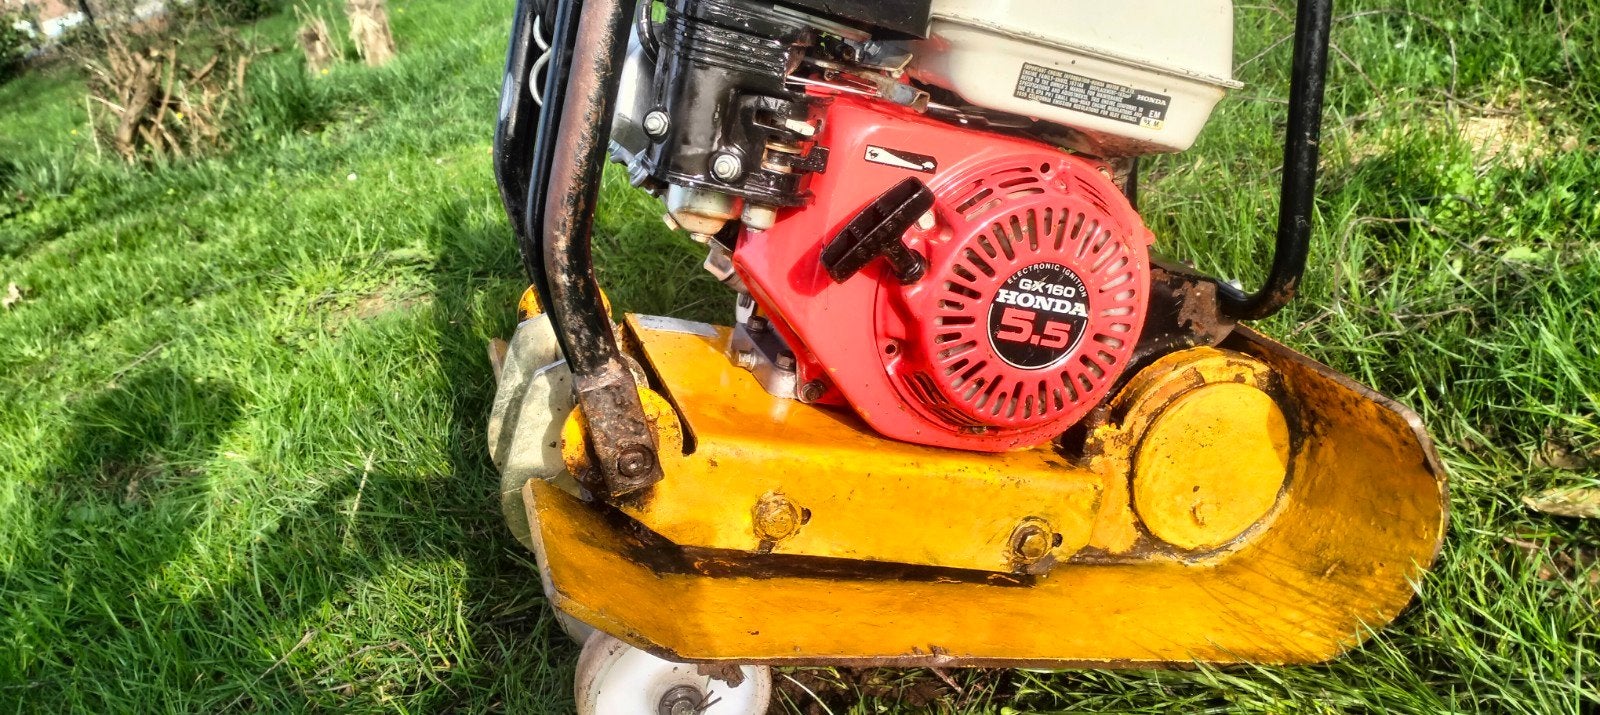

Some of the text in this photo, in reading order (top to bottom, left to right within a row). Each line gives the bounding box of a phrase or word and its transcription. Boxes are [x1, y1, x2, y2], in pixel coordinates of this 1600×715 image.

[1137, 95, 1166, 105] HONDA
[1149, 110, 1161, 118] EM
[1007, 263, 1087, 297] ELECTRONIC IGNITION
[1019, 278, 1076, 298] GX160
[996, 289, 1088, 318] HONDA
[997, 308, 1071, 349] 5.5
